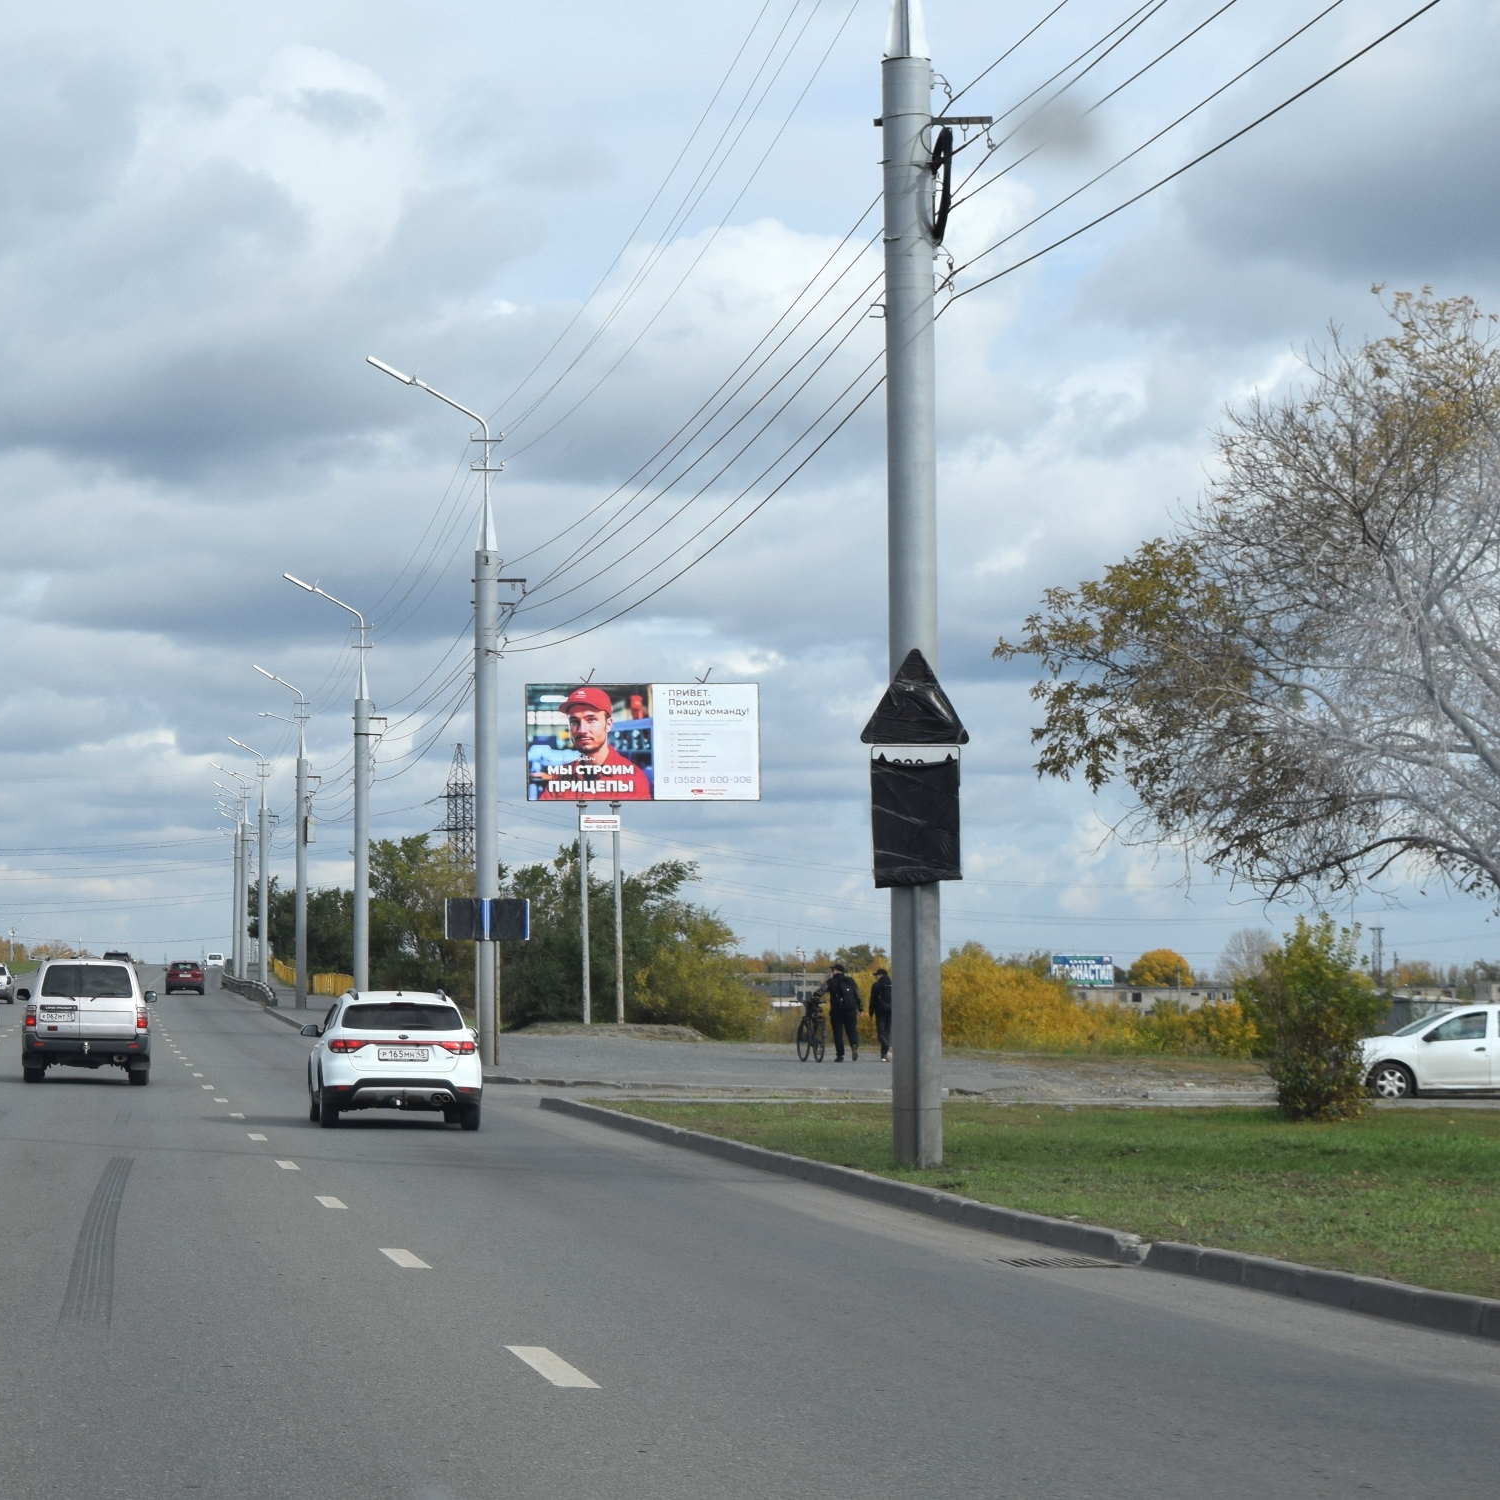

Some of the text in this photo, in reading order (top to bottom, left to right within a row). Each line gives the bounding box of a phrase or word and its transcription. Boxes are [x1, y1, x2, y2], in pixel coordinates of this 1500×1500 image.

[668, 689, 710, 697] ПРИВЕТ.
[668, 698, 712, 707] Приходи
[705, 707, 749, 716] команду!
[547, 764, 634, 775] МЫ СТРОИМ
[663, 775, 752, 785] 8 (3522) 600-306
[548, 780, 634, 794] ПРИЦЕПЫ
[1051, 964, 1113, 980] ПРОФНАСТИЛ
